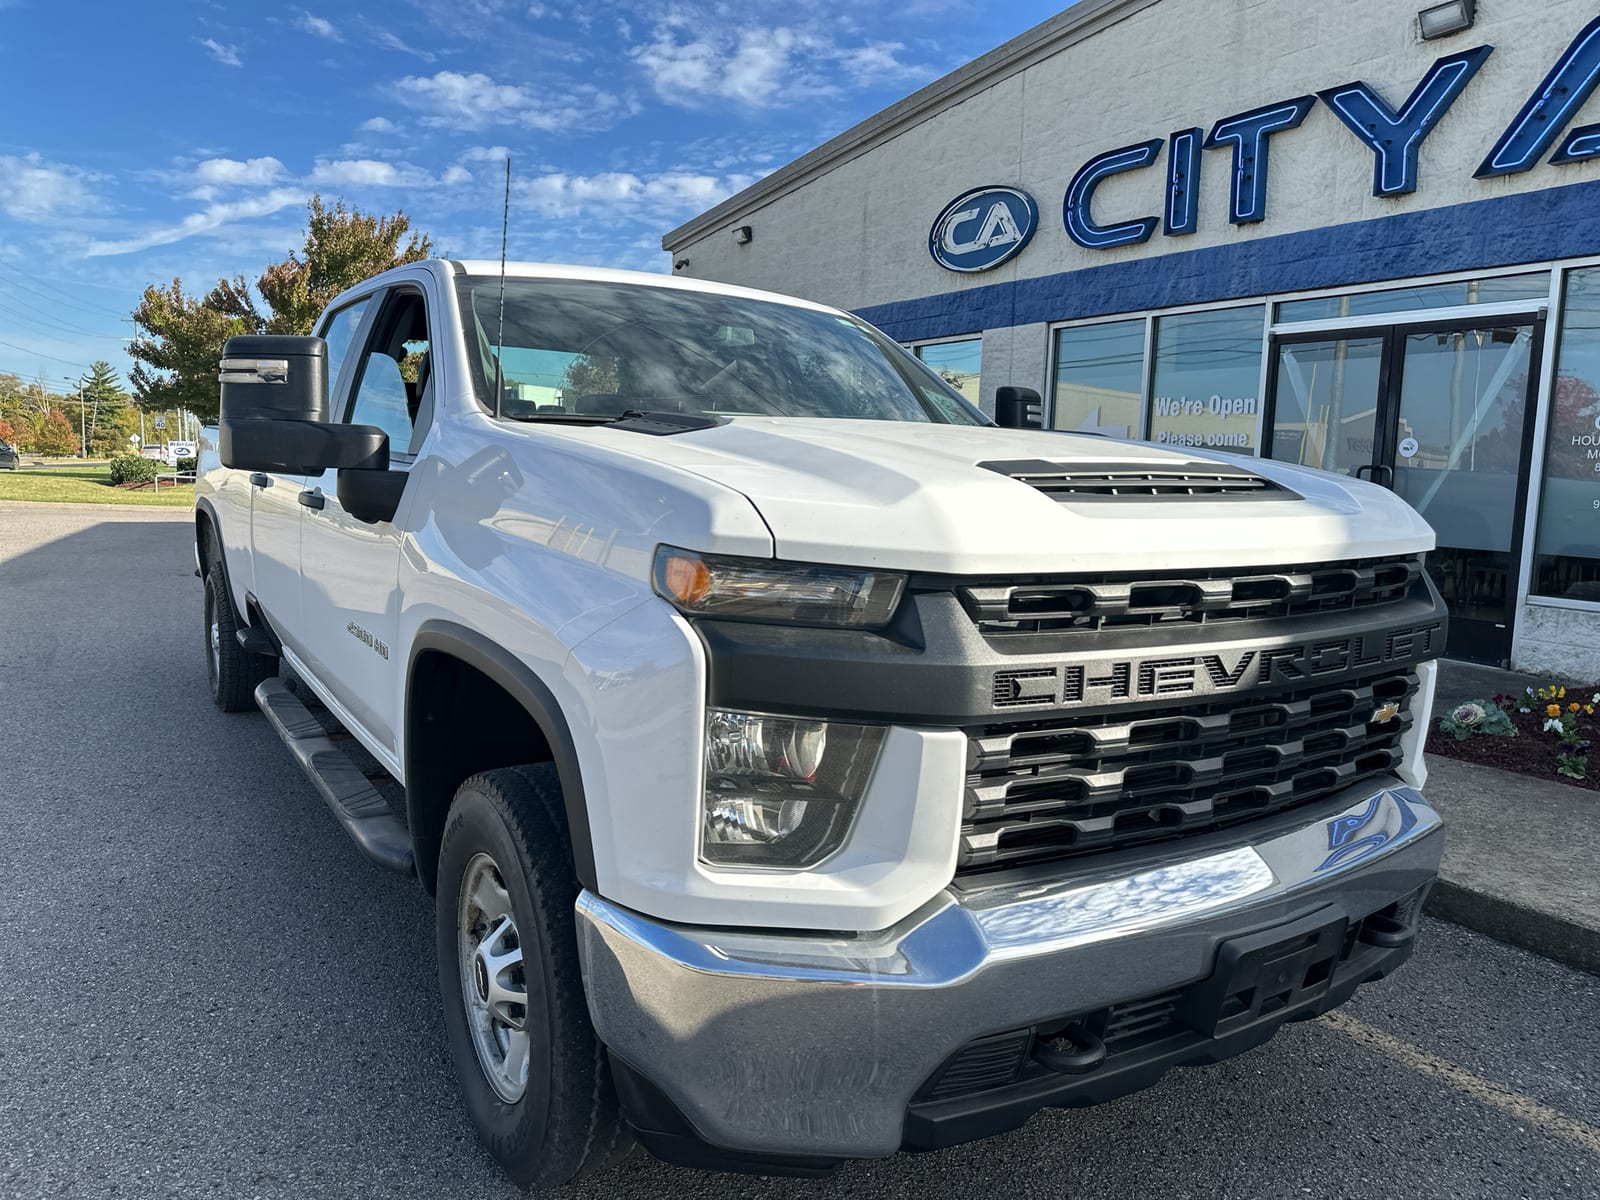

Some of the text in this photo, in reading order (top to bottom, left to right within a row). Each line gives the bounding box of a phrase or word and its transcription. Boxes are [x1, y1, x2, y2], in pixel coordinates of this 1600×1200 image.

[1063, 45, 1495, 249] CITY
[942, 202, 1021, 255] CA
[1155, 395, 1257, 419] We're Open
[1158, 431, 1248, 446] Please come
[992, 621, 1442, 709] CHEVROLET
